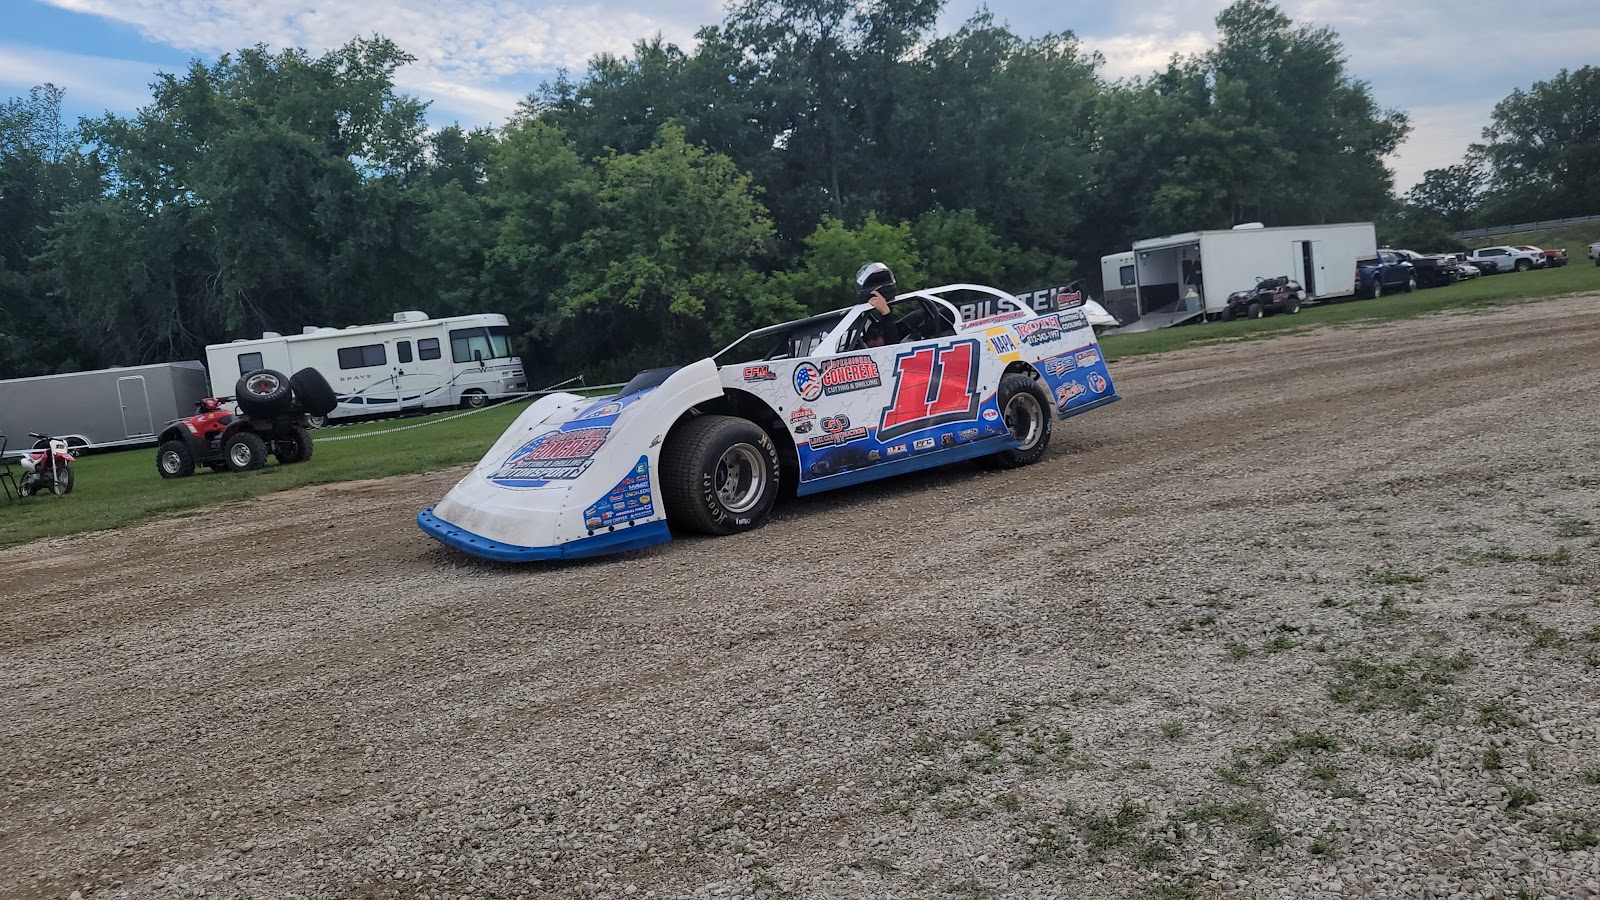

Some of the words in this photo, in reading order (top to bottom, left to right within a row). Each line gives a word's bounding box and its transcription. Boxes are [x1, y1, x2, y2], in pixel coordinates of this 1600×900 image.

[1015, 315, 1061, 338] ROTH
[1061, 322, 1080, 331] COOLING
[990, 335, 1017, 354] NAPA
[821, 356, 873, 370] PROFESSIONAL
[340, 374, 373, 382] BRAVE
[743, 365, 768, 378] CFM
[823, 363, 879, 386] CONCRETE
[827, 384, 850, 394] CUTTING
[855, 379, 878, 390] DRILLING
[880, 340, 977, 436] 11
[983, 411, 997, 419] PEM
[824, 427, 866, 442] CONSTRUCTION
[525, 438, 606, 460] CONCRETE
[915, 439, 932, 447] PFC
[487, 459, 594, 479] MOTORSPORTS
